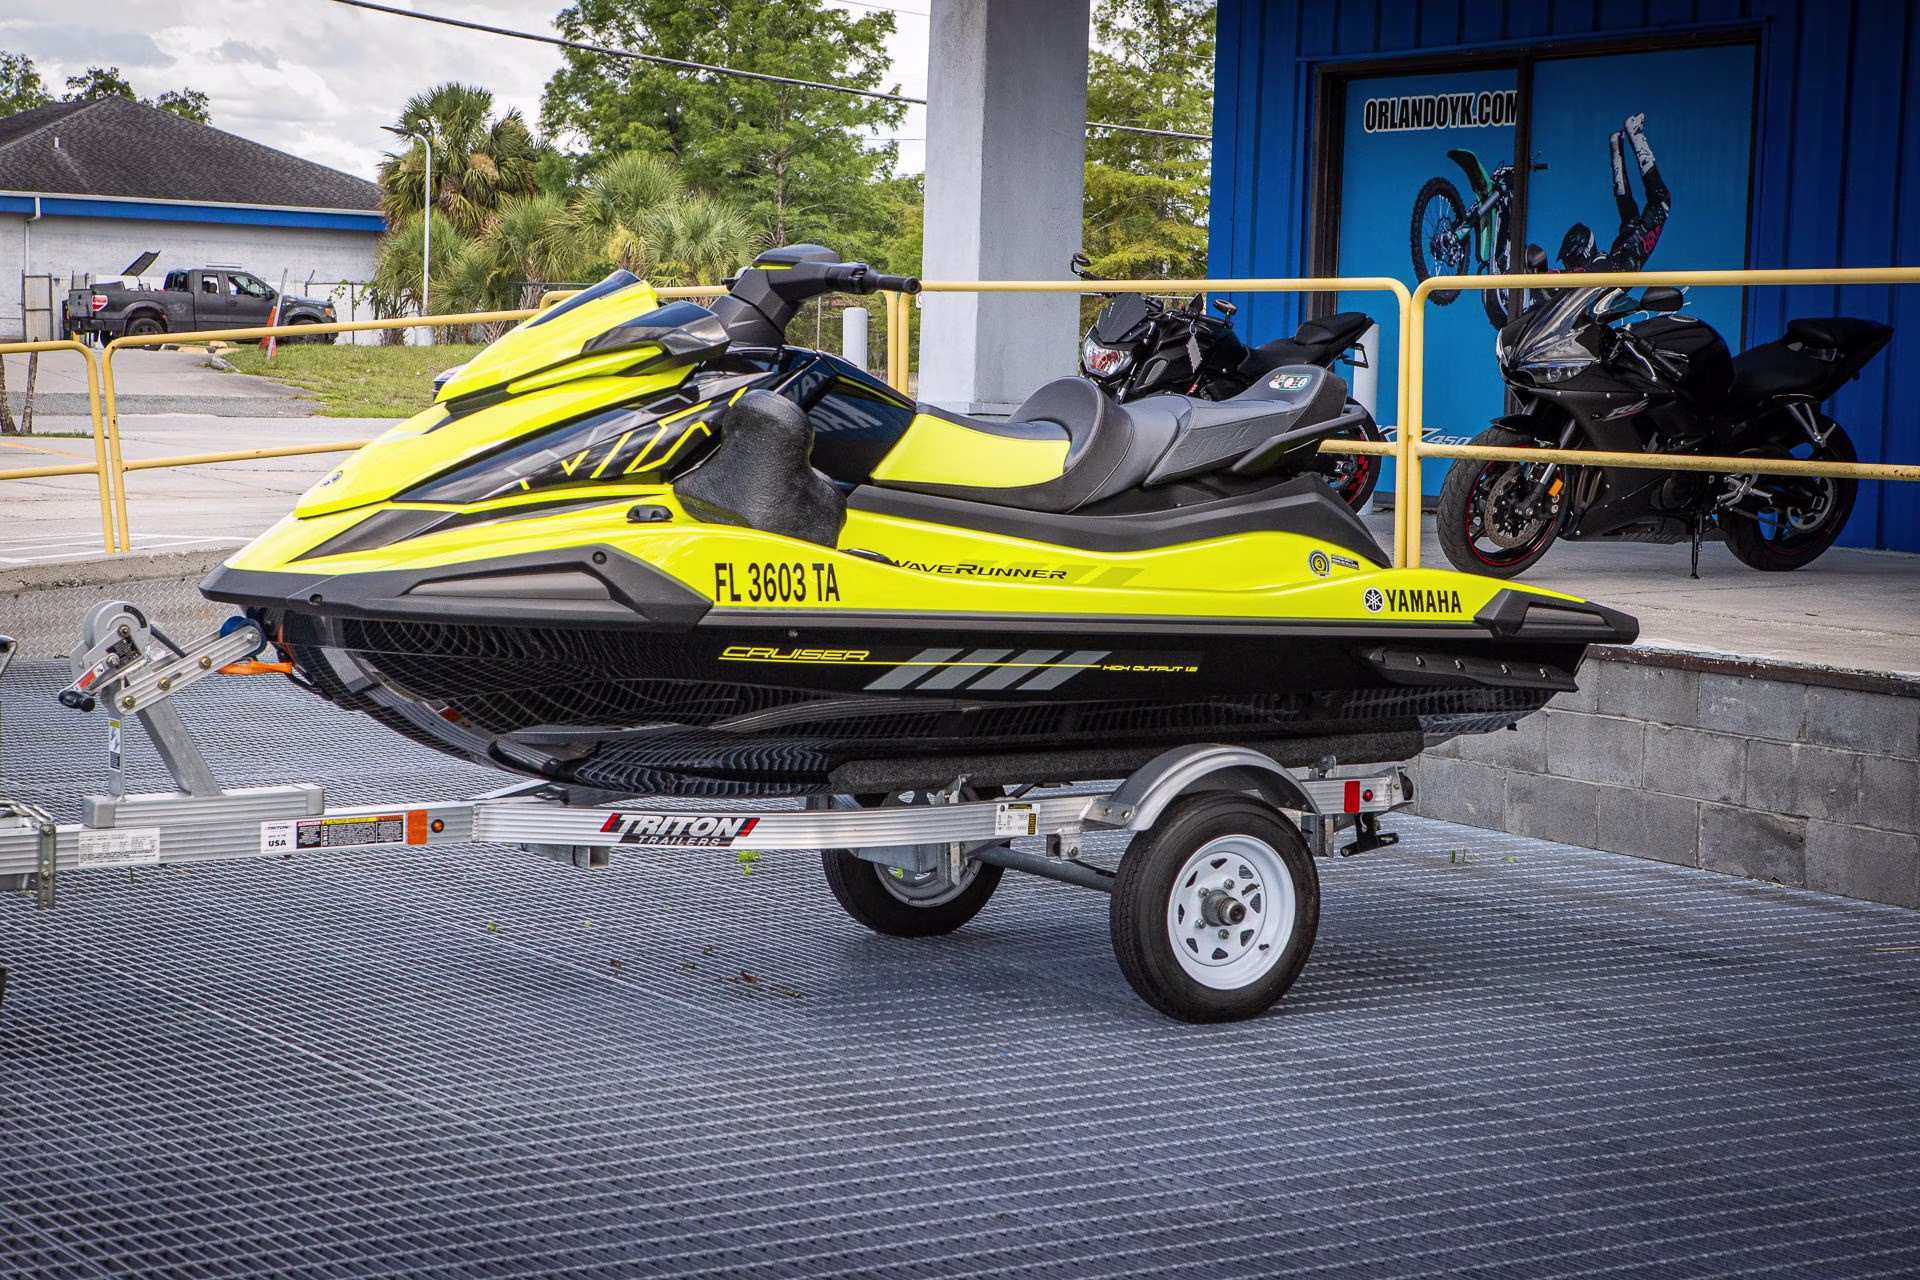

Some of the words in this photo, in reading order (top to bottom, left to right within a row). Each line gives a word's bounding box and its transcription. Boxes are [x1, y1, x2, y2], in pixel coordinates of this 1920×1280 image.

[715, 562, 742, 602] FL
[747, 562, 806, 603] 3603
[812, 562, 841, 602] TA
[1385, 588, 1462, 613] YAMAHA
[722, 645, 870, 661] CRUISER
[1102, 664, 1131, 672] HIGH
[1132, 665, 1184, 673] OUTPUT
[617, 814, 746, 838] TRITON
[268, 839, 287, 847] USA
[638, 835, 721, 847] TRAILERS
